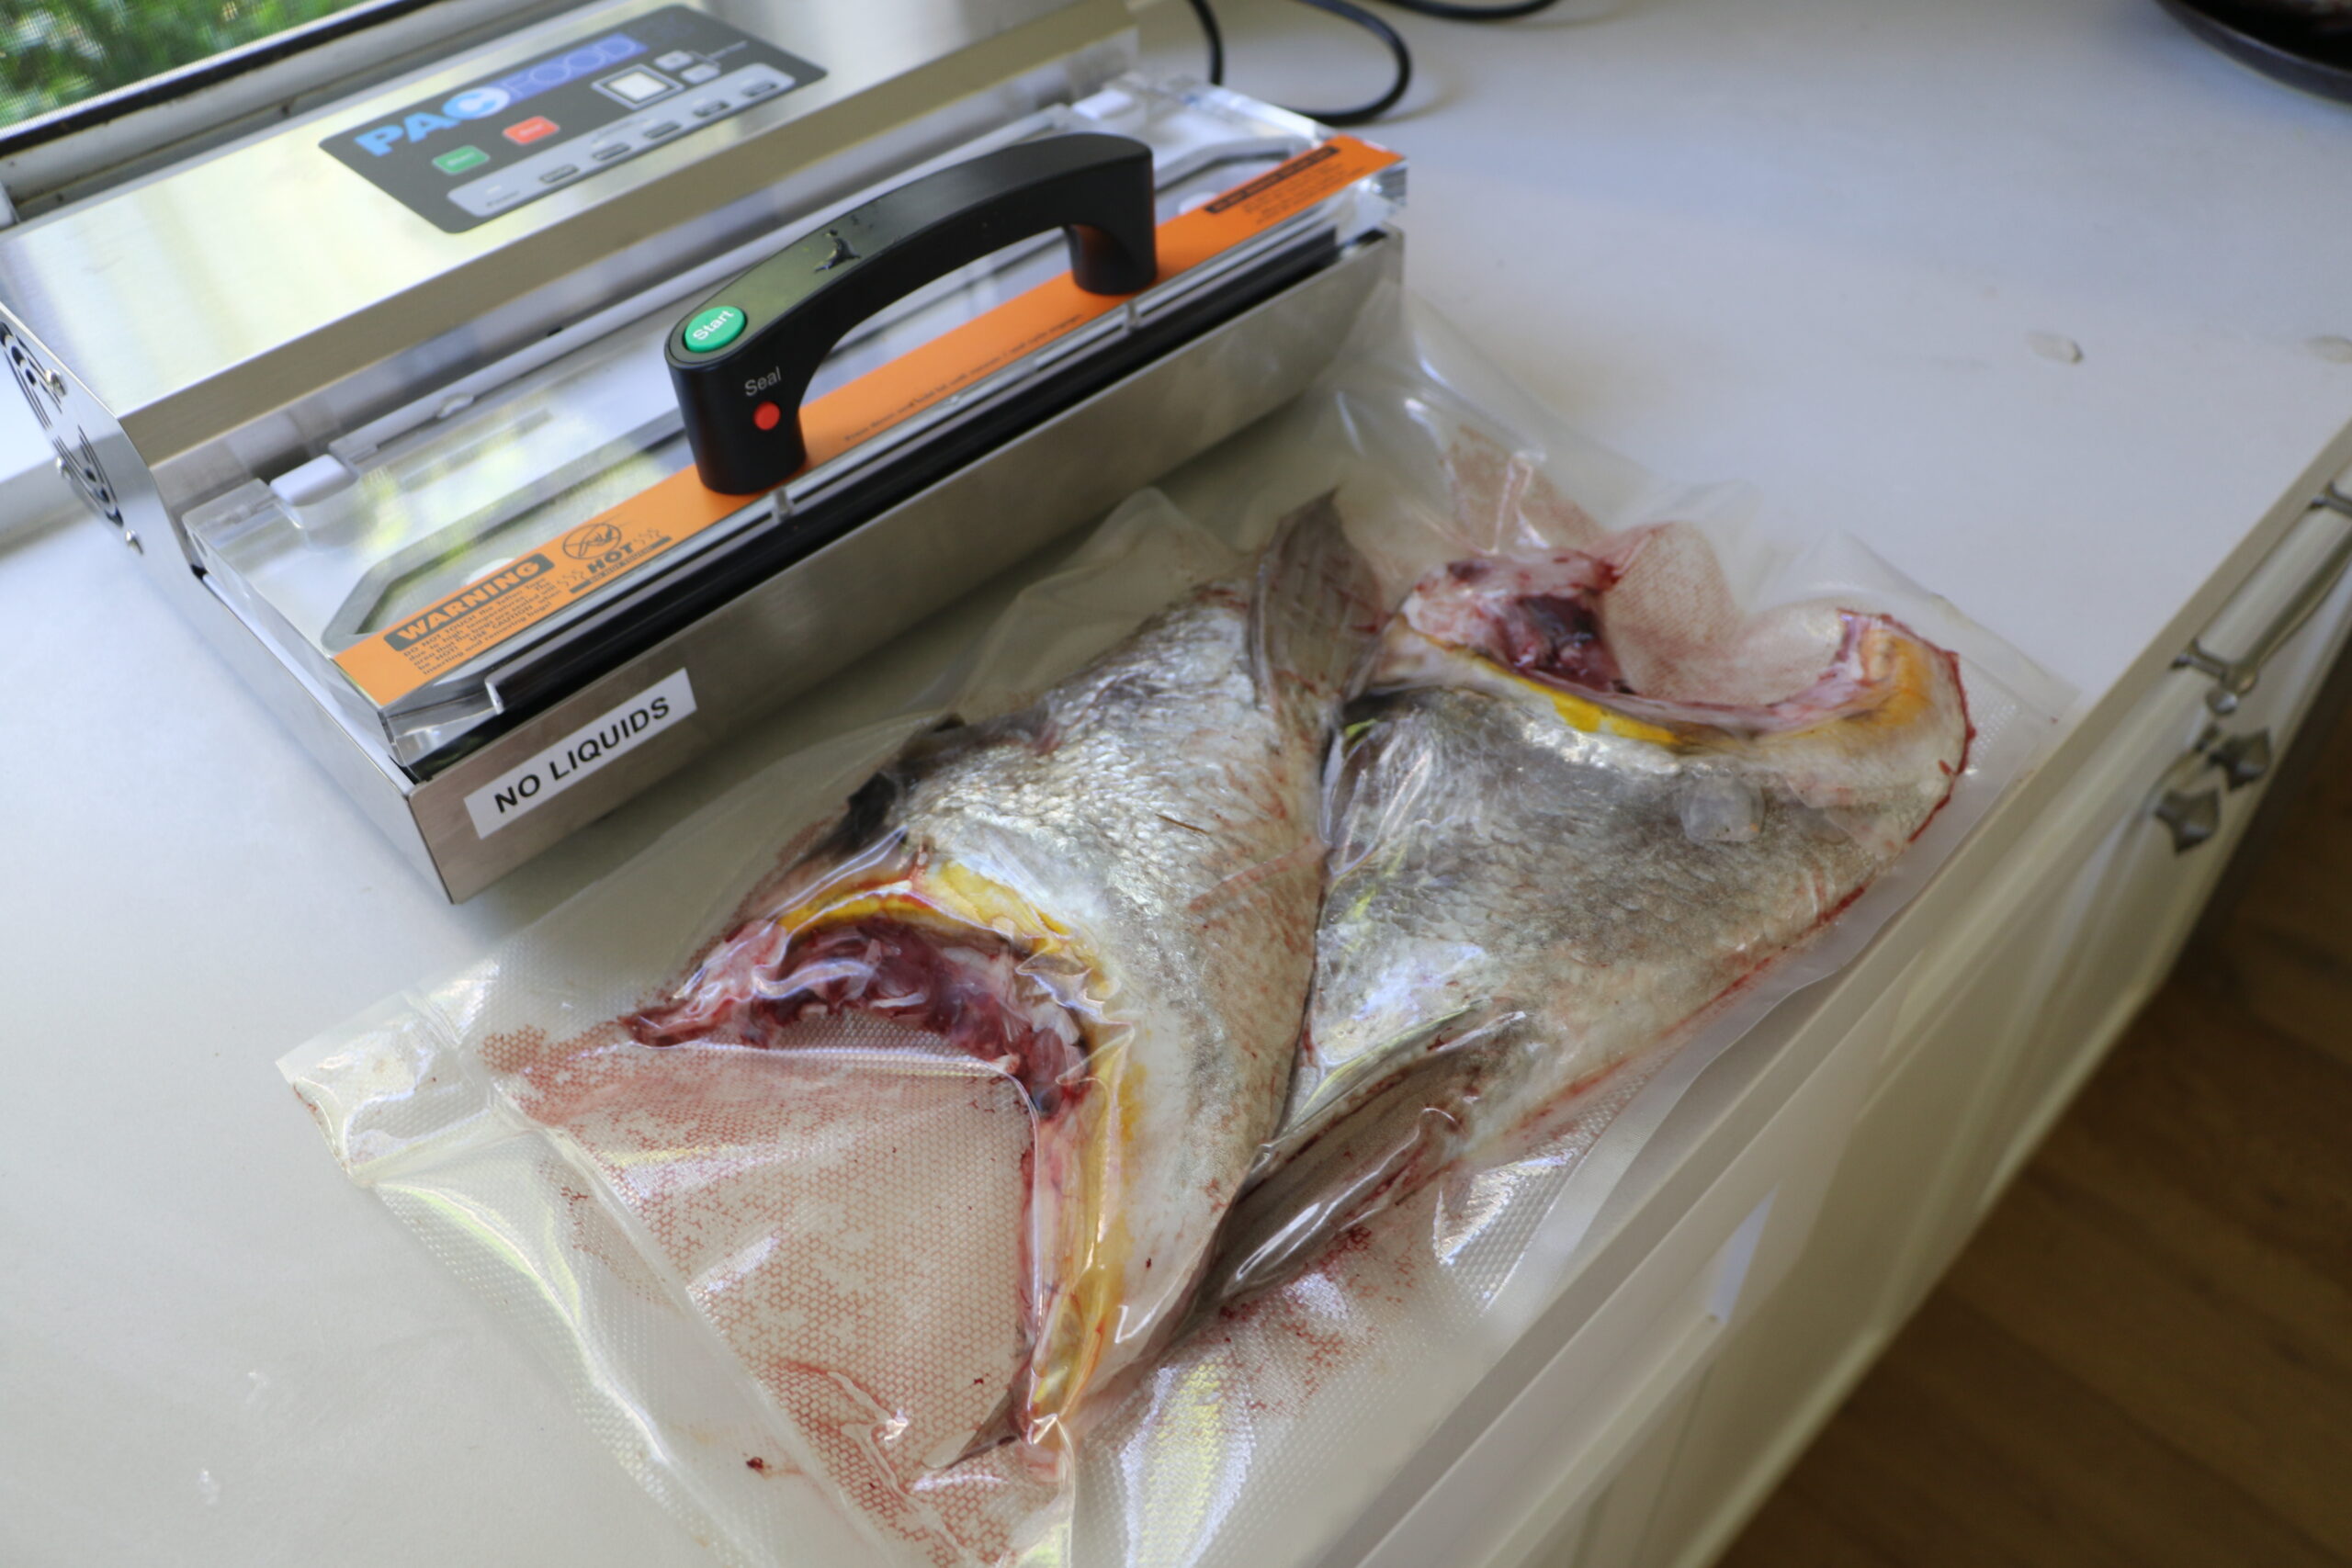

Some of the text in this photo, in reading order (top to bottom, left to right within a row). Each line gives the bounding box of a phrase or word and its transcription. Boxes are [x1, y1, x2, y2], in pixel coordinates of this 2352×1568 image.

[692, 310, 734, 341] Start
[745, 366, 782, 397] Seal
[587, 542, 633, 573] HOT
[397, 561, 540, 640] WARNING
[493, 696, 670, 813] NO LIQUIDS
